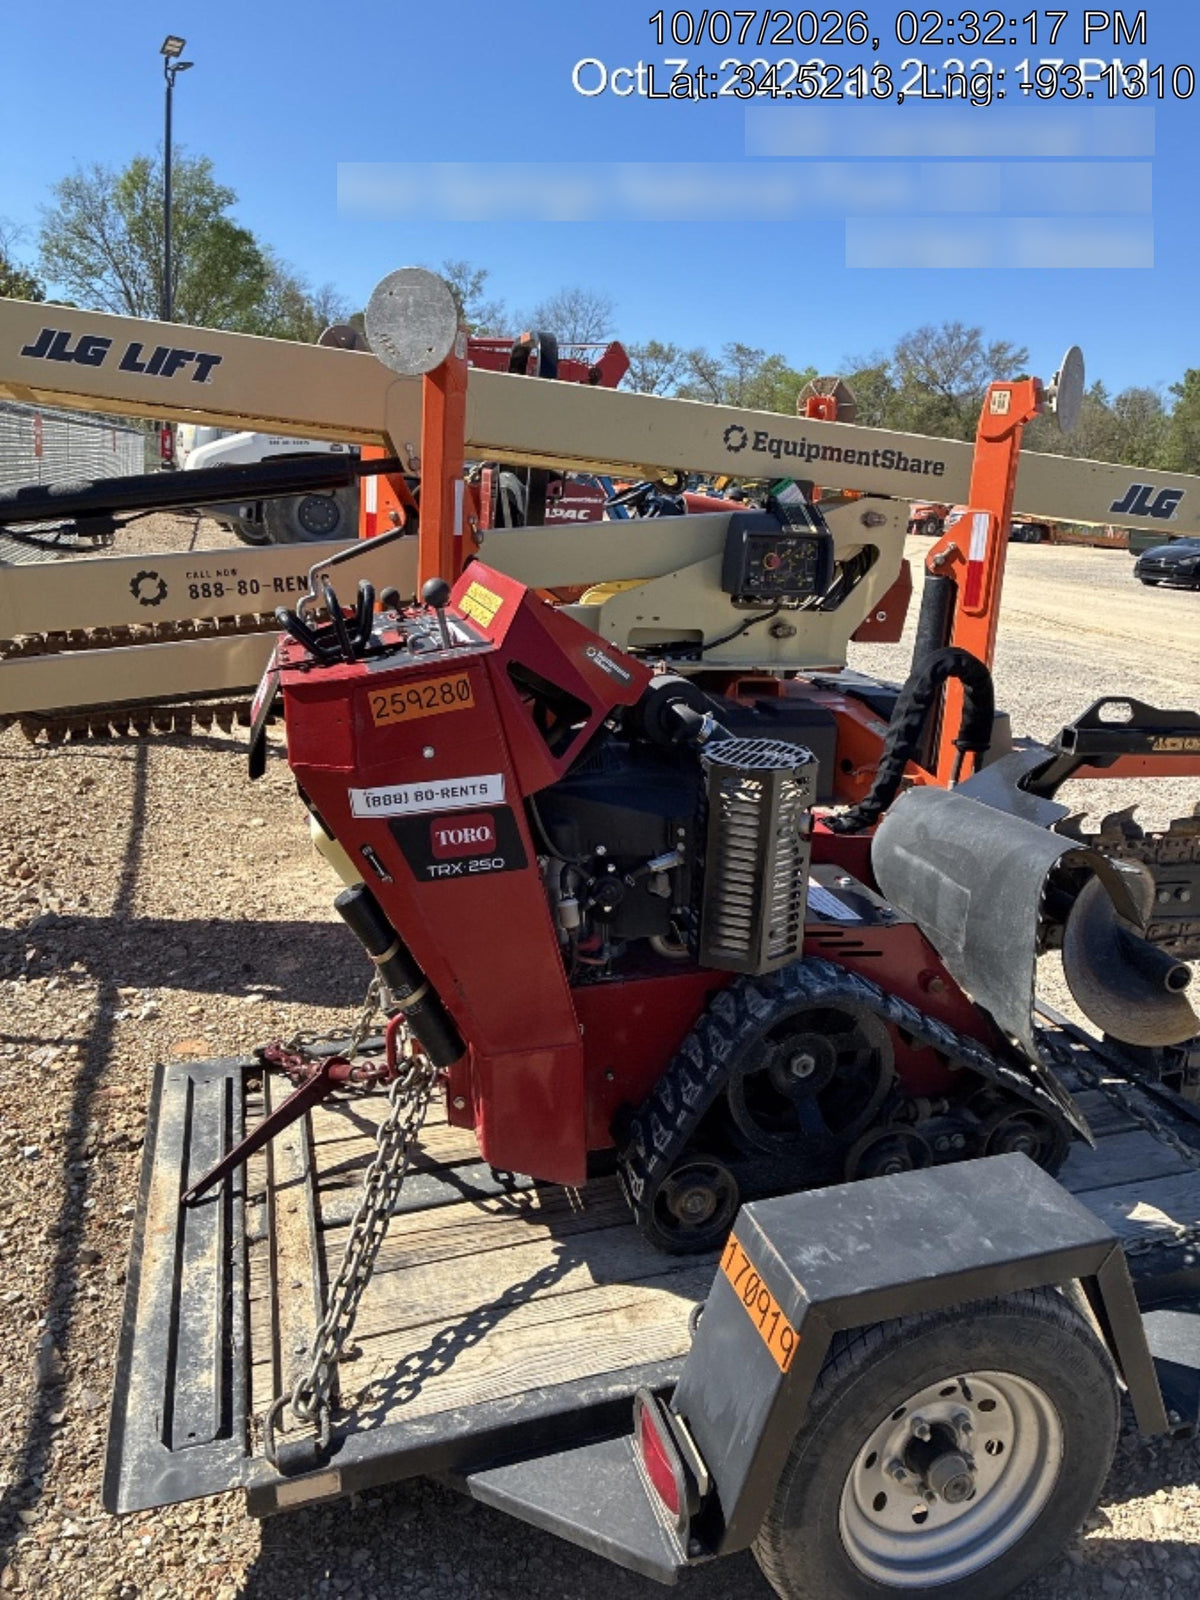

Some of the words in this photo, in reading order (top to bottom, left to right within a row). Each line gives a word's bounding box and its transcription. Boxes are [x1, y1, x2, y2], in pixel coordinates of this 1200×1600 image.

[20, 328, 113, 367] JLG
[118, 342, 223, 383] LIFT
[752, 430, 945, 477] EquipmentShare
[1109, 484, 1185, 520] JLG
[186, 571, 212, 580] CALL
[372, 678, 471, 719] 259280
[365, 789, 409, 808] (888)
[413, 782, 489, 802] 80-RENTS
[434, 825, 492, 846] TORO
[725, 1242, 794, 1369] 170919
